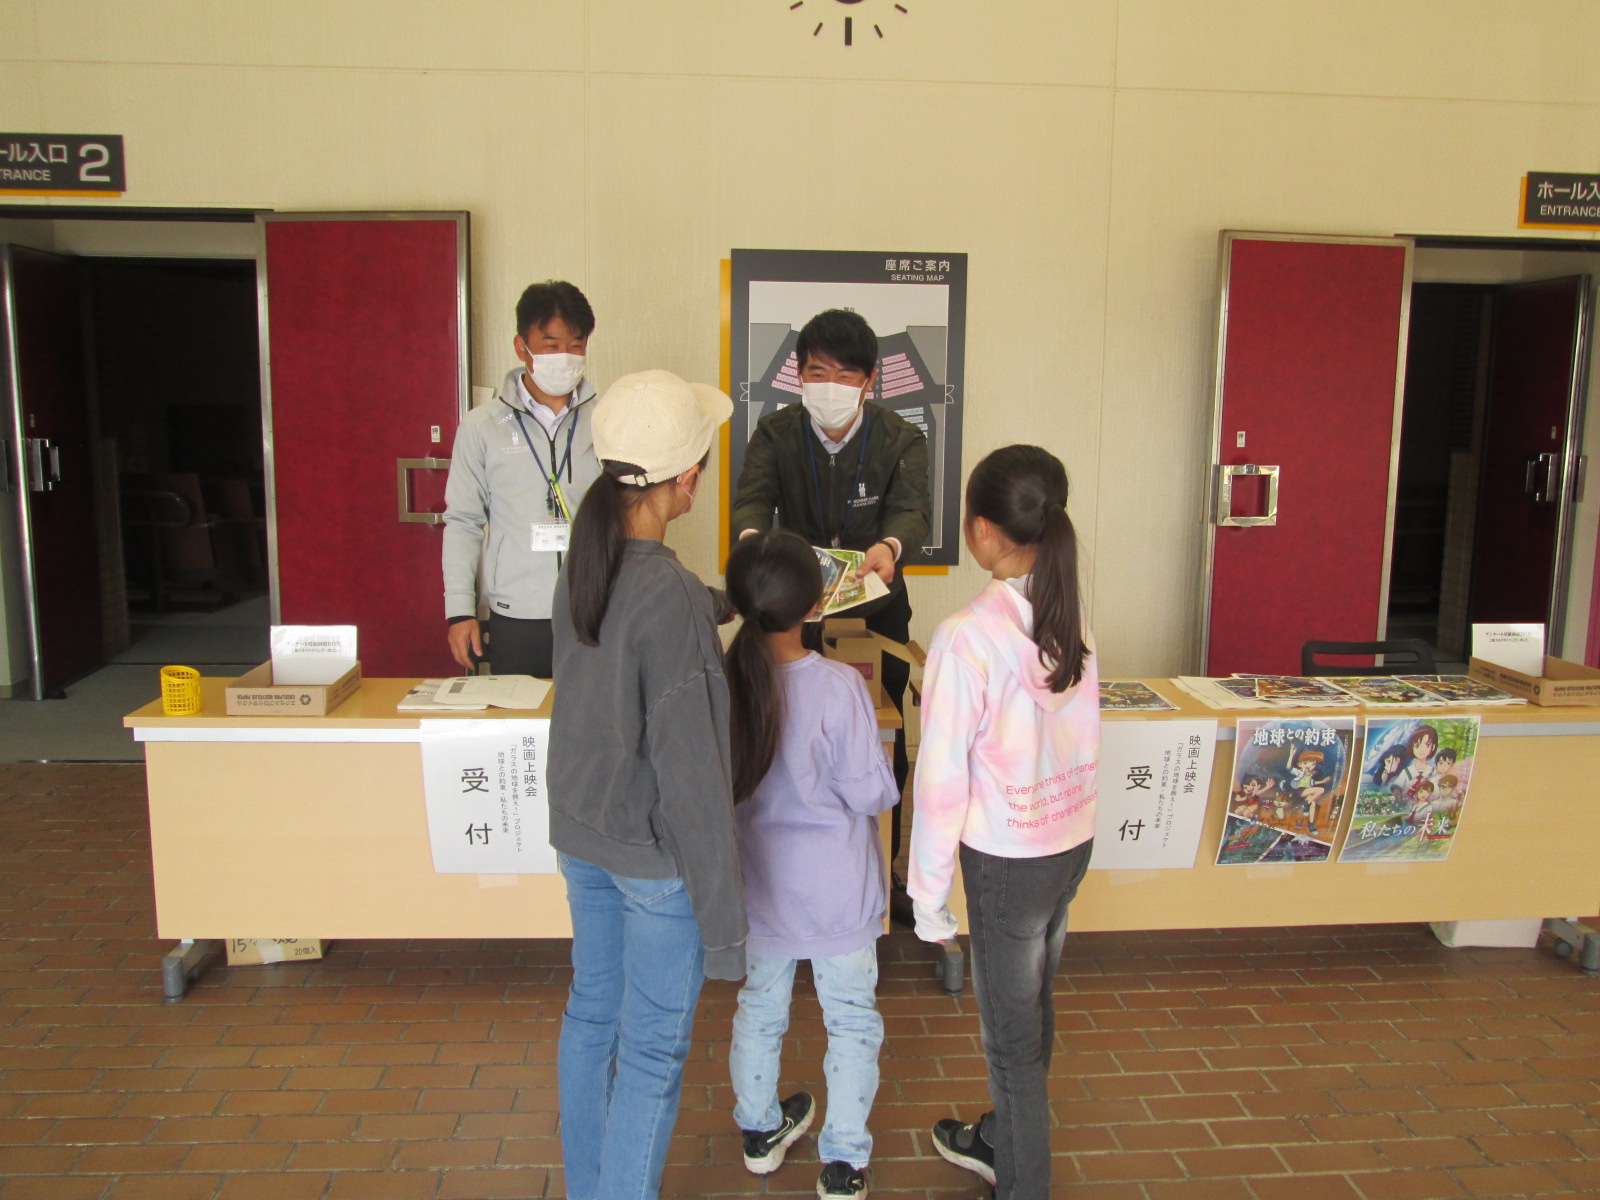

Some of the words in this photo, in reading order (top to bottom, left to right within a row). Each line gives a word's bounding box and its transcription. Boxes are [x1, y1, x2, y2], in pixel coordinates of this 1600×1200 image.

[79, 143, 110, 182] 2
[885, 259, 950, 272] 座席ご案内
[891, 274, 925, 282] SEATING
[1253, 727, 1337, 747] 地球との約束
[522, 736, 538, 797] 映画上映会
[1183, 734, 1201, 794] 映画上映会
[461, 767, 493, 845] 受付
[1008, 802, 1027, 812] the
[1049, 792, 1063, 804] but
[1118, 765, 1153, 841] 受付
[1007, 818, 1040, 829] thinks
[1040, 814, 1050, 826] of
[1359, 812, 1451, 842] 私たちの未来
